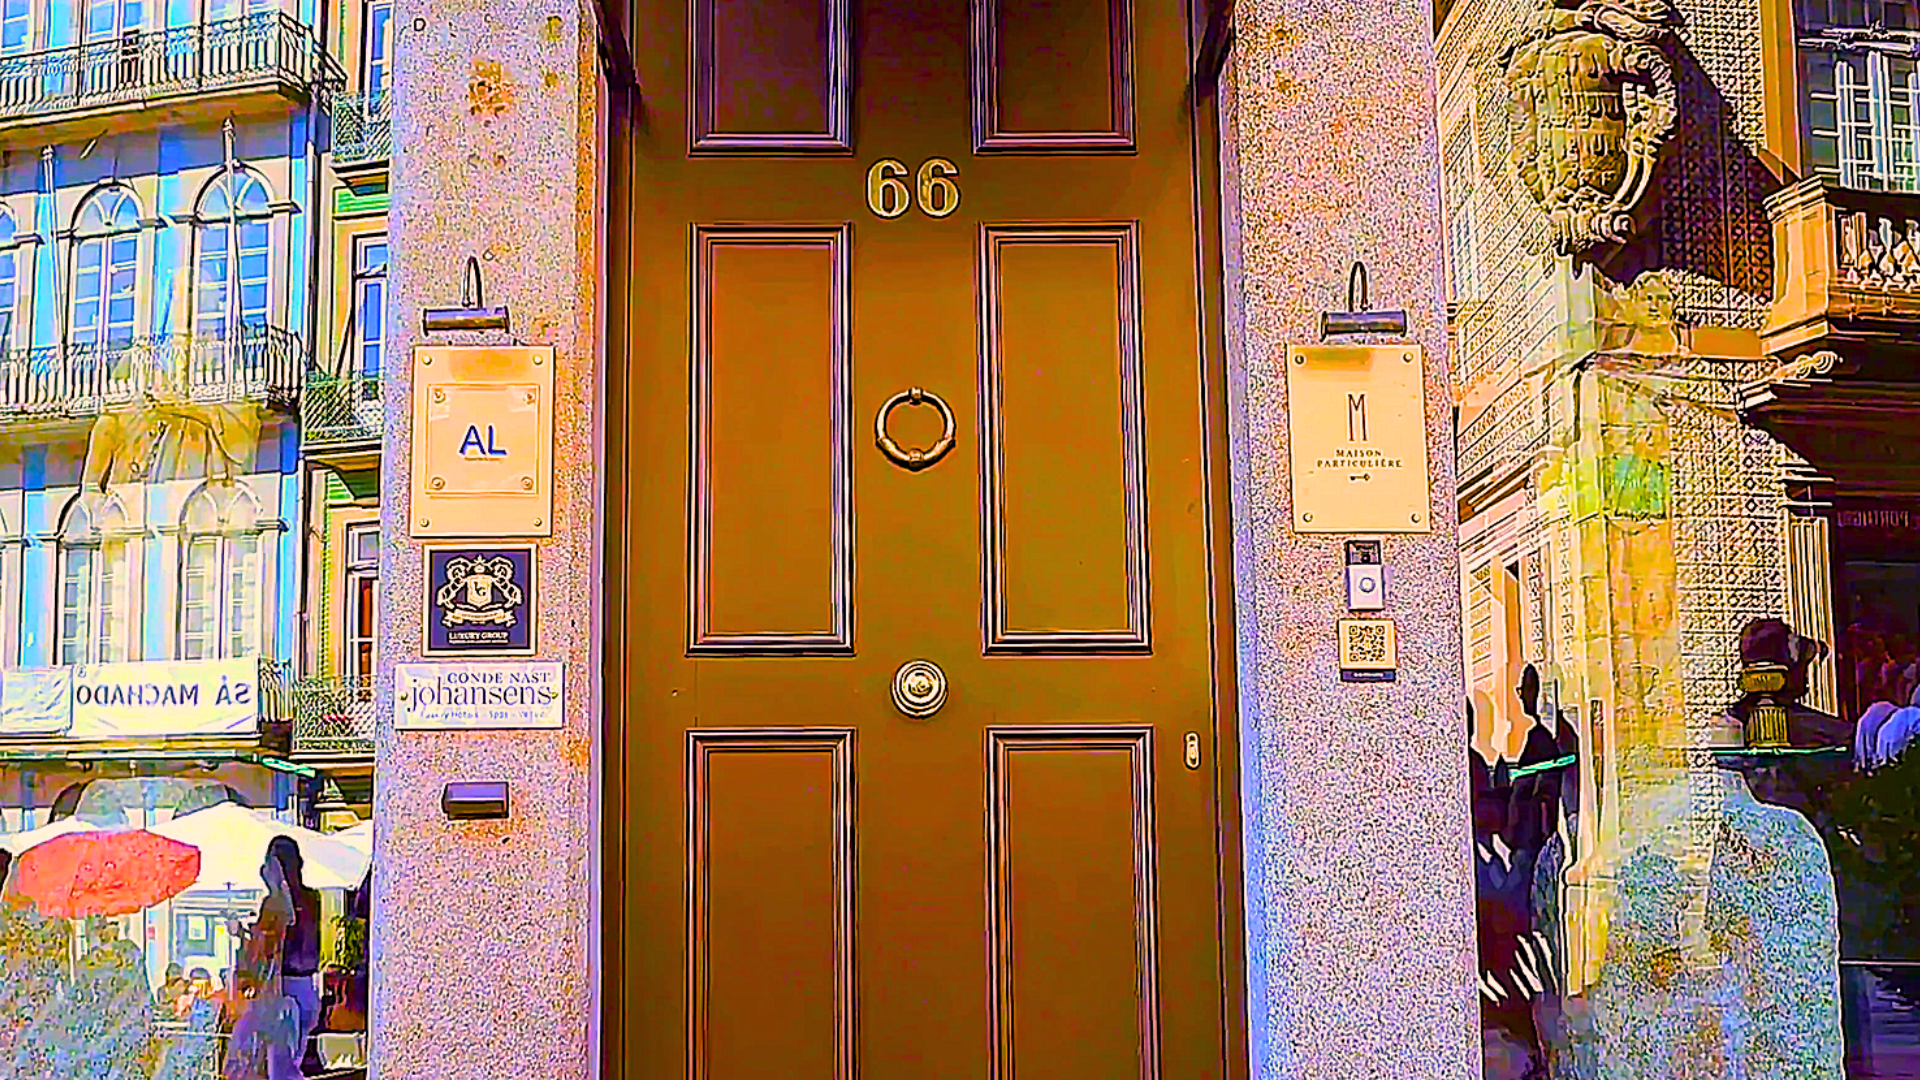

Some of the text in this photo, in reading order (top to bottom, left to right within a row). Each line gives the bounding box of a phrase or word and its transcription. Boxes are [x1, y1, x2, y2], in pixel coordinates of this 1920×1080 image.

[866, 156, 961, 218] 66
[1347, 393, 1369, 442] M
[459, 424, 507, 456] AL
[1335, 449, 1382, 458] MAISON
[481, 631, 509, 639] GROUP
[407, 676, 553, 712] johansens
[509, 672, 551, 684] NAST
